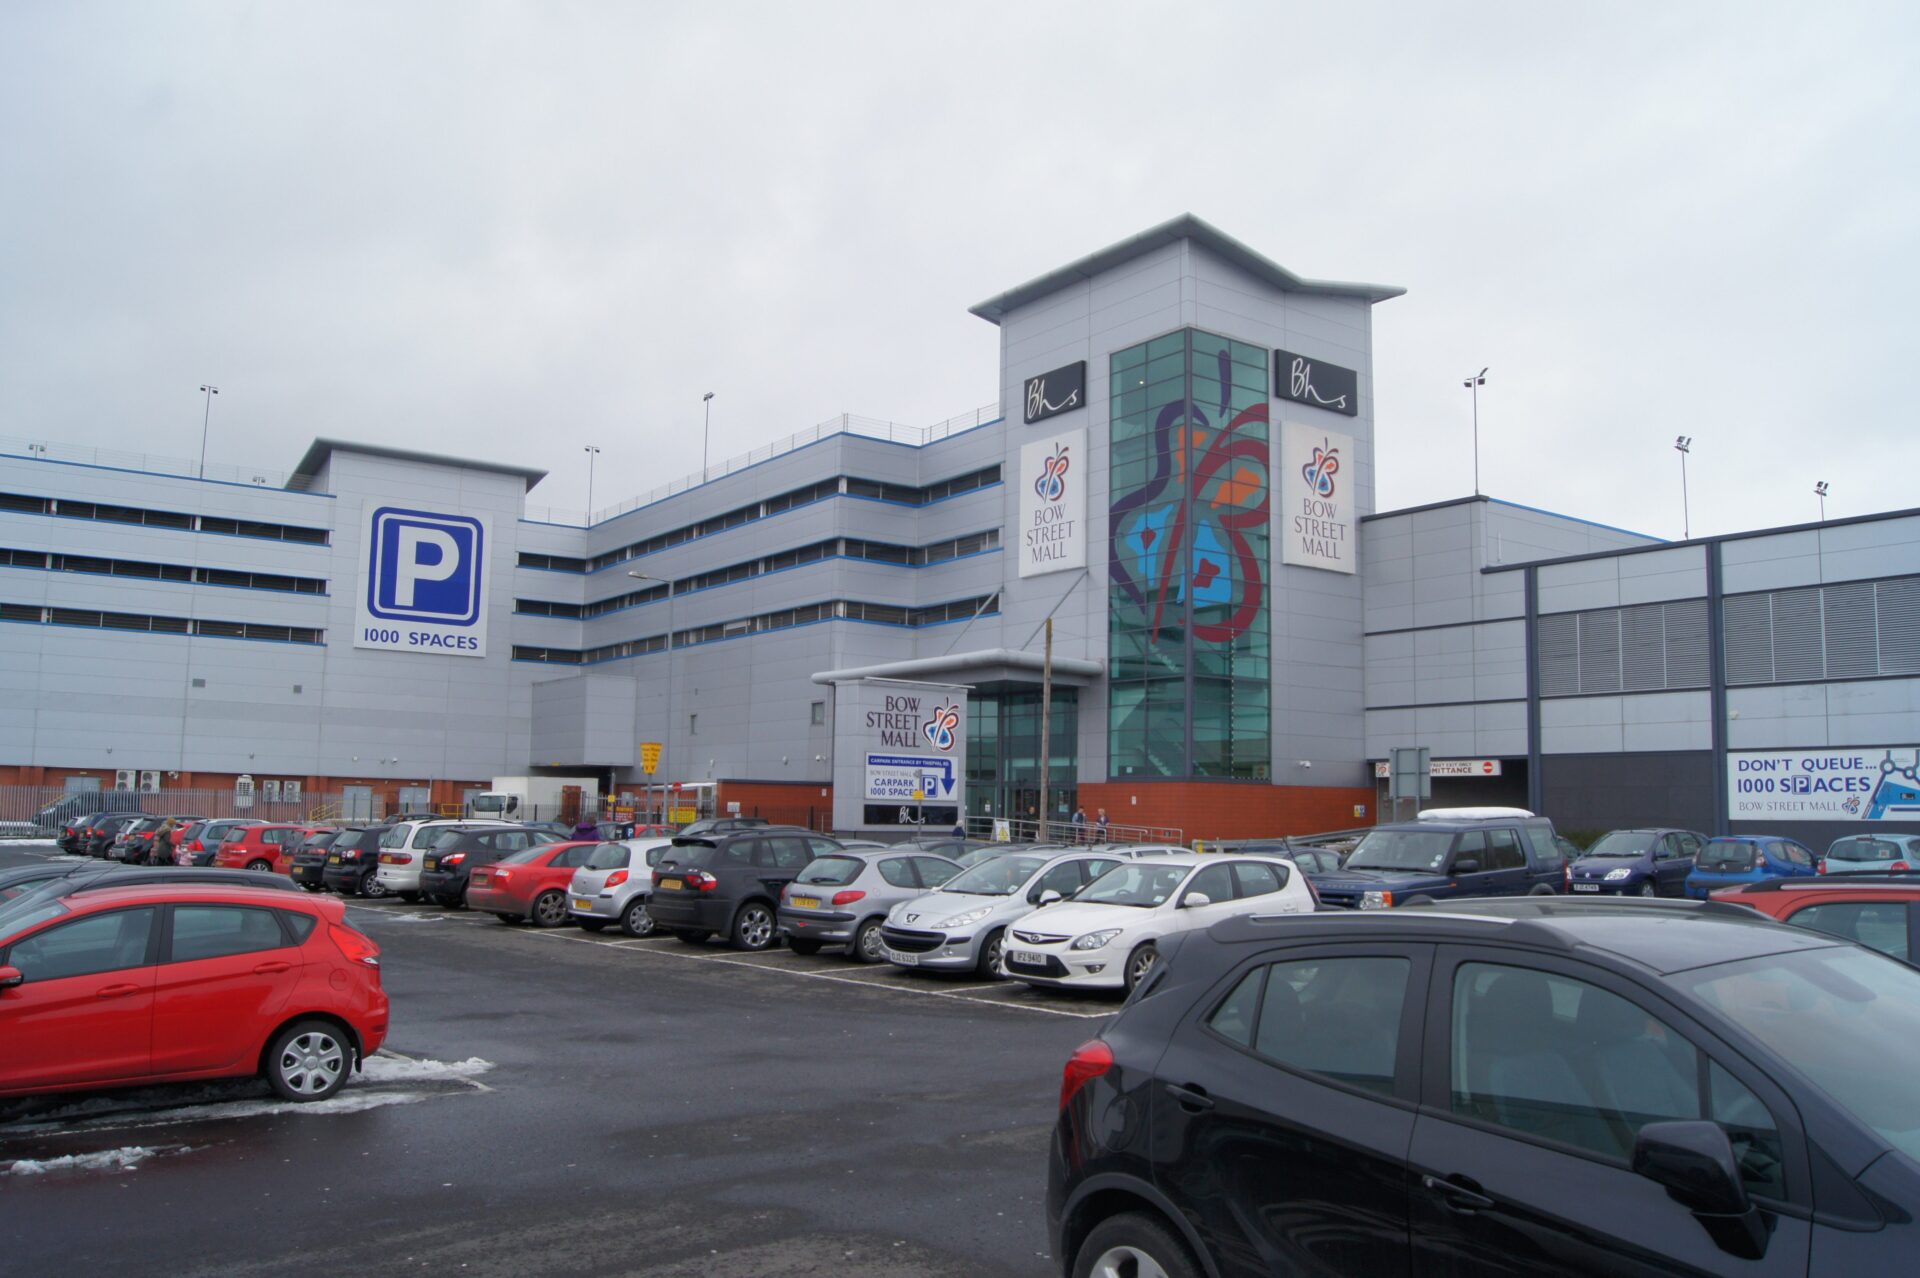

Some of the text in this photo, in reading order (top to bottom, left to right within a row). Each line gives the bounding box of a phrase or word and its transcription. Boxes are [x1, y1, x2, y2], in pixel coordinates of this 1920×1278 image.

[1291, 357, 1347, 409] Bhs
[1027, 378, 1078, 419] Bhs
[1034, 503, 1066, 526] BOW
[1303, 498, 1337, 519] BOW
[1026, 520, 1075, 547] STREET
[1294, 515, 1347, 541] STREET
[1031, 541, 1068, 564] MALL
[1302, 536, 1342, 560] MALL
[364, 627, 478, 650] 1000 SPACES
[886, 695, 921, 713] BOW
[866, 711, 921, 731] STREET
[881, 729, 921, 748] MALL
[1738, 757, 1877, 772] DON'T QUEUE...
[870, 788, 886, 796] 1000
[874, 778, 914, 787] CARPARK
[1737, 778, 1775, 793] 1000
[899, 806, 926, 824] Bhs
[1739, 801, 1839, 812] BOW STREET MALL
